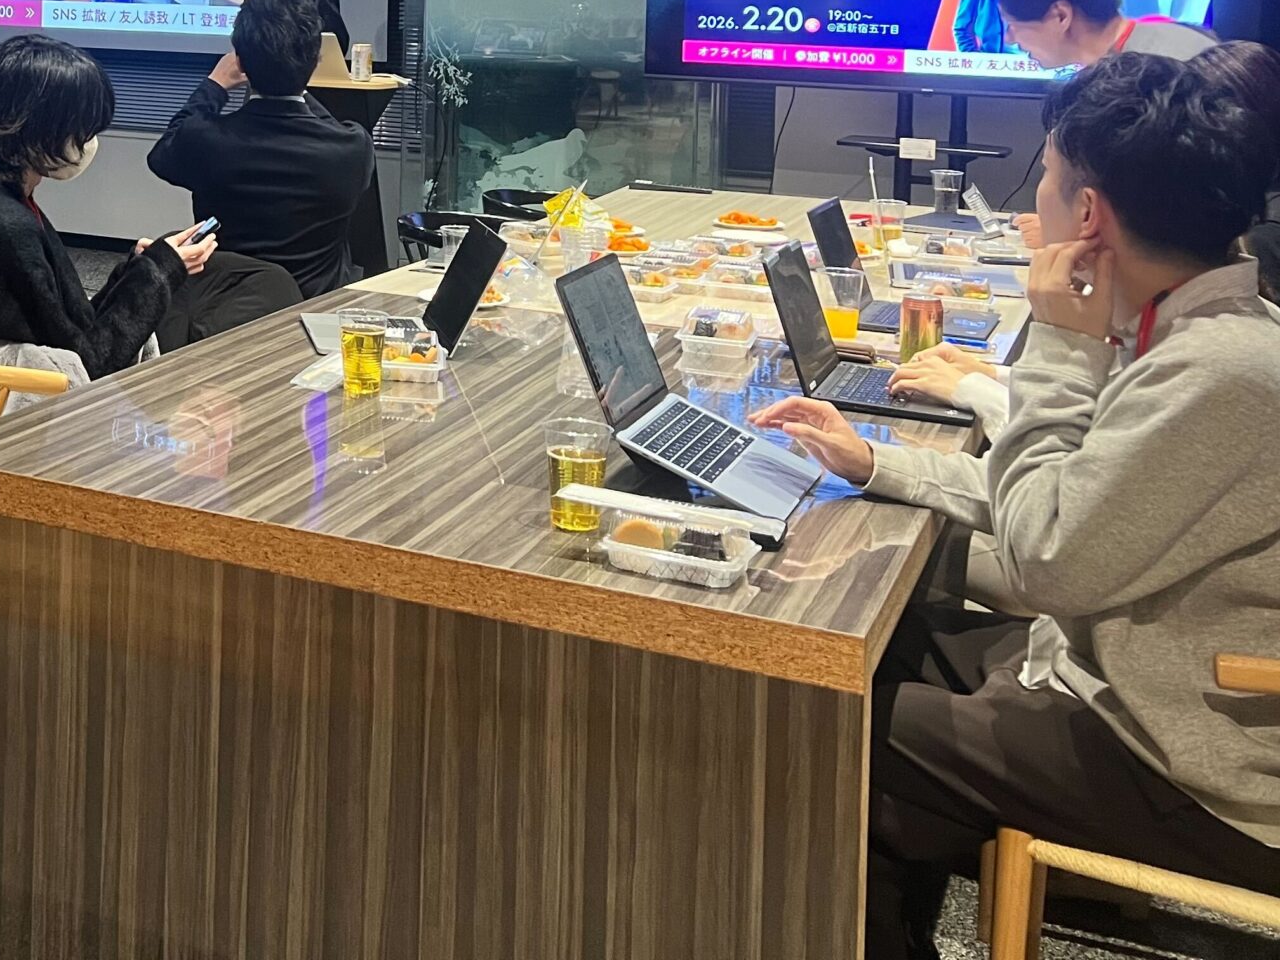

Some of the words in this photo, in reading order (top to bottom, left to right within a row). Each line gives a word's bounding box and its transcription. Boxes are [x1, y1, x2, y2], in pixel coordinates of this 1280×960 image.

[52, 8, 77, 21] SNS
[82, 9, 107, 23] 拡散
[119, 10, 169, 25] 友人誘致
[182, 13, 195, 26] LT
[698, 16, 739, 30] 2026.
[742, 5, 804, 32] 2.20
[827, 23, 900, 35] @西新宿五丁目
[698, 46, 775, 61] オフライン開催
[832, 52, 875, 66] ¥1,000
[915, 56, 942, 67] SNS
[948, 57, 973, 70] 拡散
